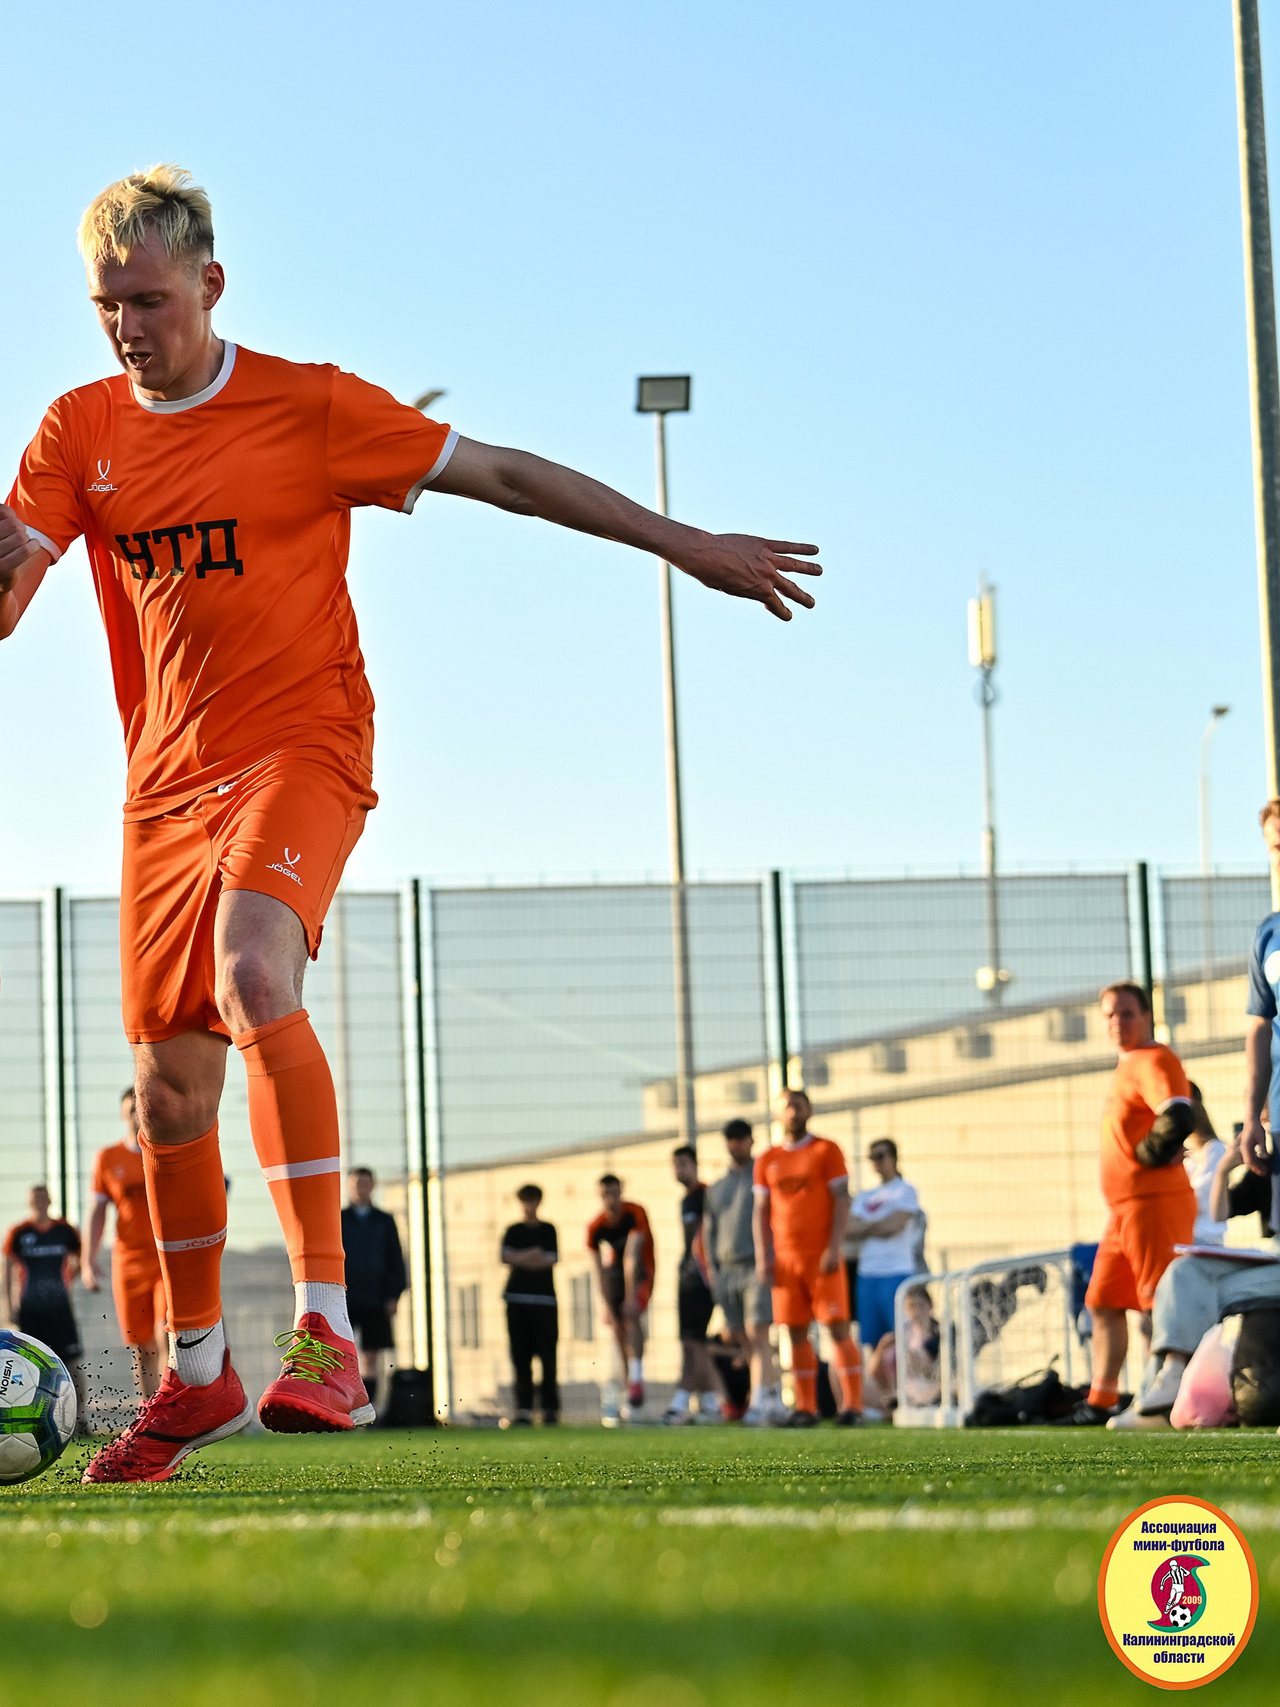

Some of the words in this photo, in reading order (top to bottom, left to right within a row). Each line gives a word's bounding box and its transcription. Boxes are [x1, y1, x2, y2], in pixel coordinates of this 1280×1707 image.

[87, 482, 118, 492] JÖGEL
[115, 518, 244, 580] НТД
[266, 863, 304, 887] JÖGEL
[0, 1359, 14, 1396] VISION
